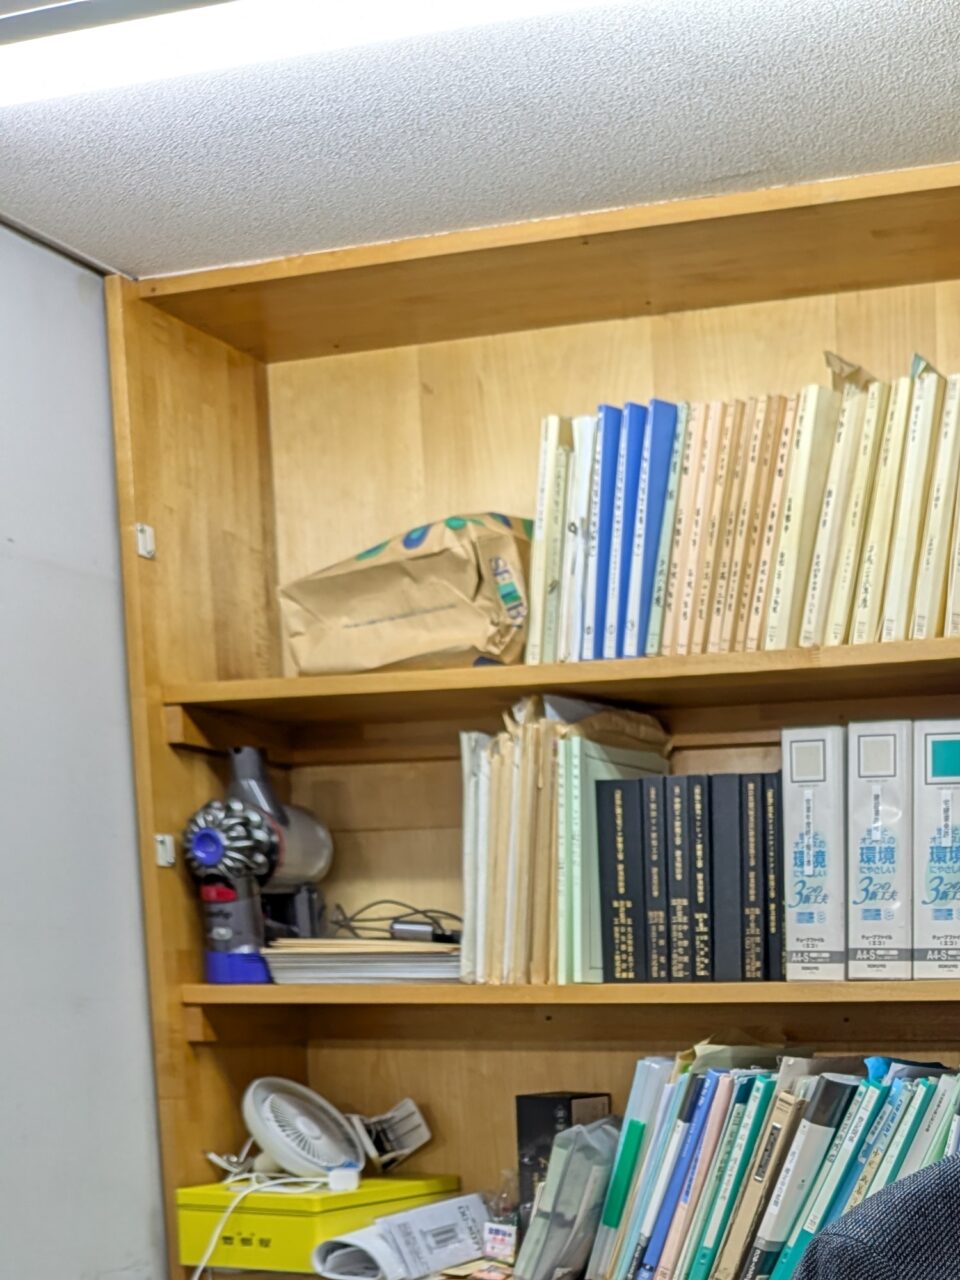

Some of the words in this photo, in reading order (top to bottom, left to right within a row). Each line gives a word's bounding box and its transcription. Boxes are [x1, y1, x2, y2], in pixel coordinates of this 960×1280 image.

[859, 846, 896, 864] 環境
[791, 952, 809, 963] A4-S
[856, 949, 876, 960] A4-S
[926, 949, 947, 960] A4-S
